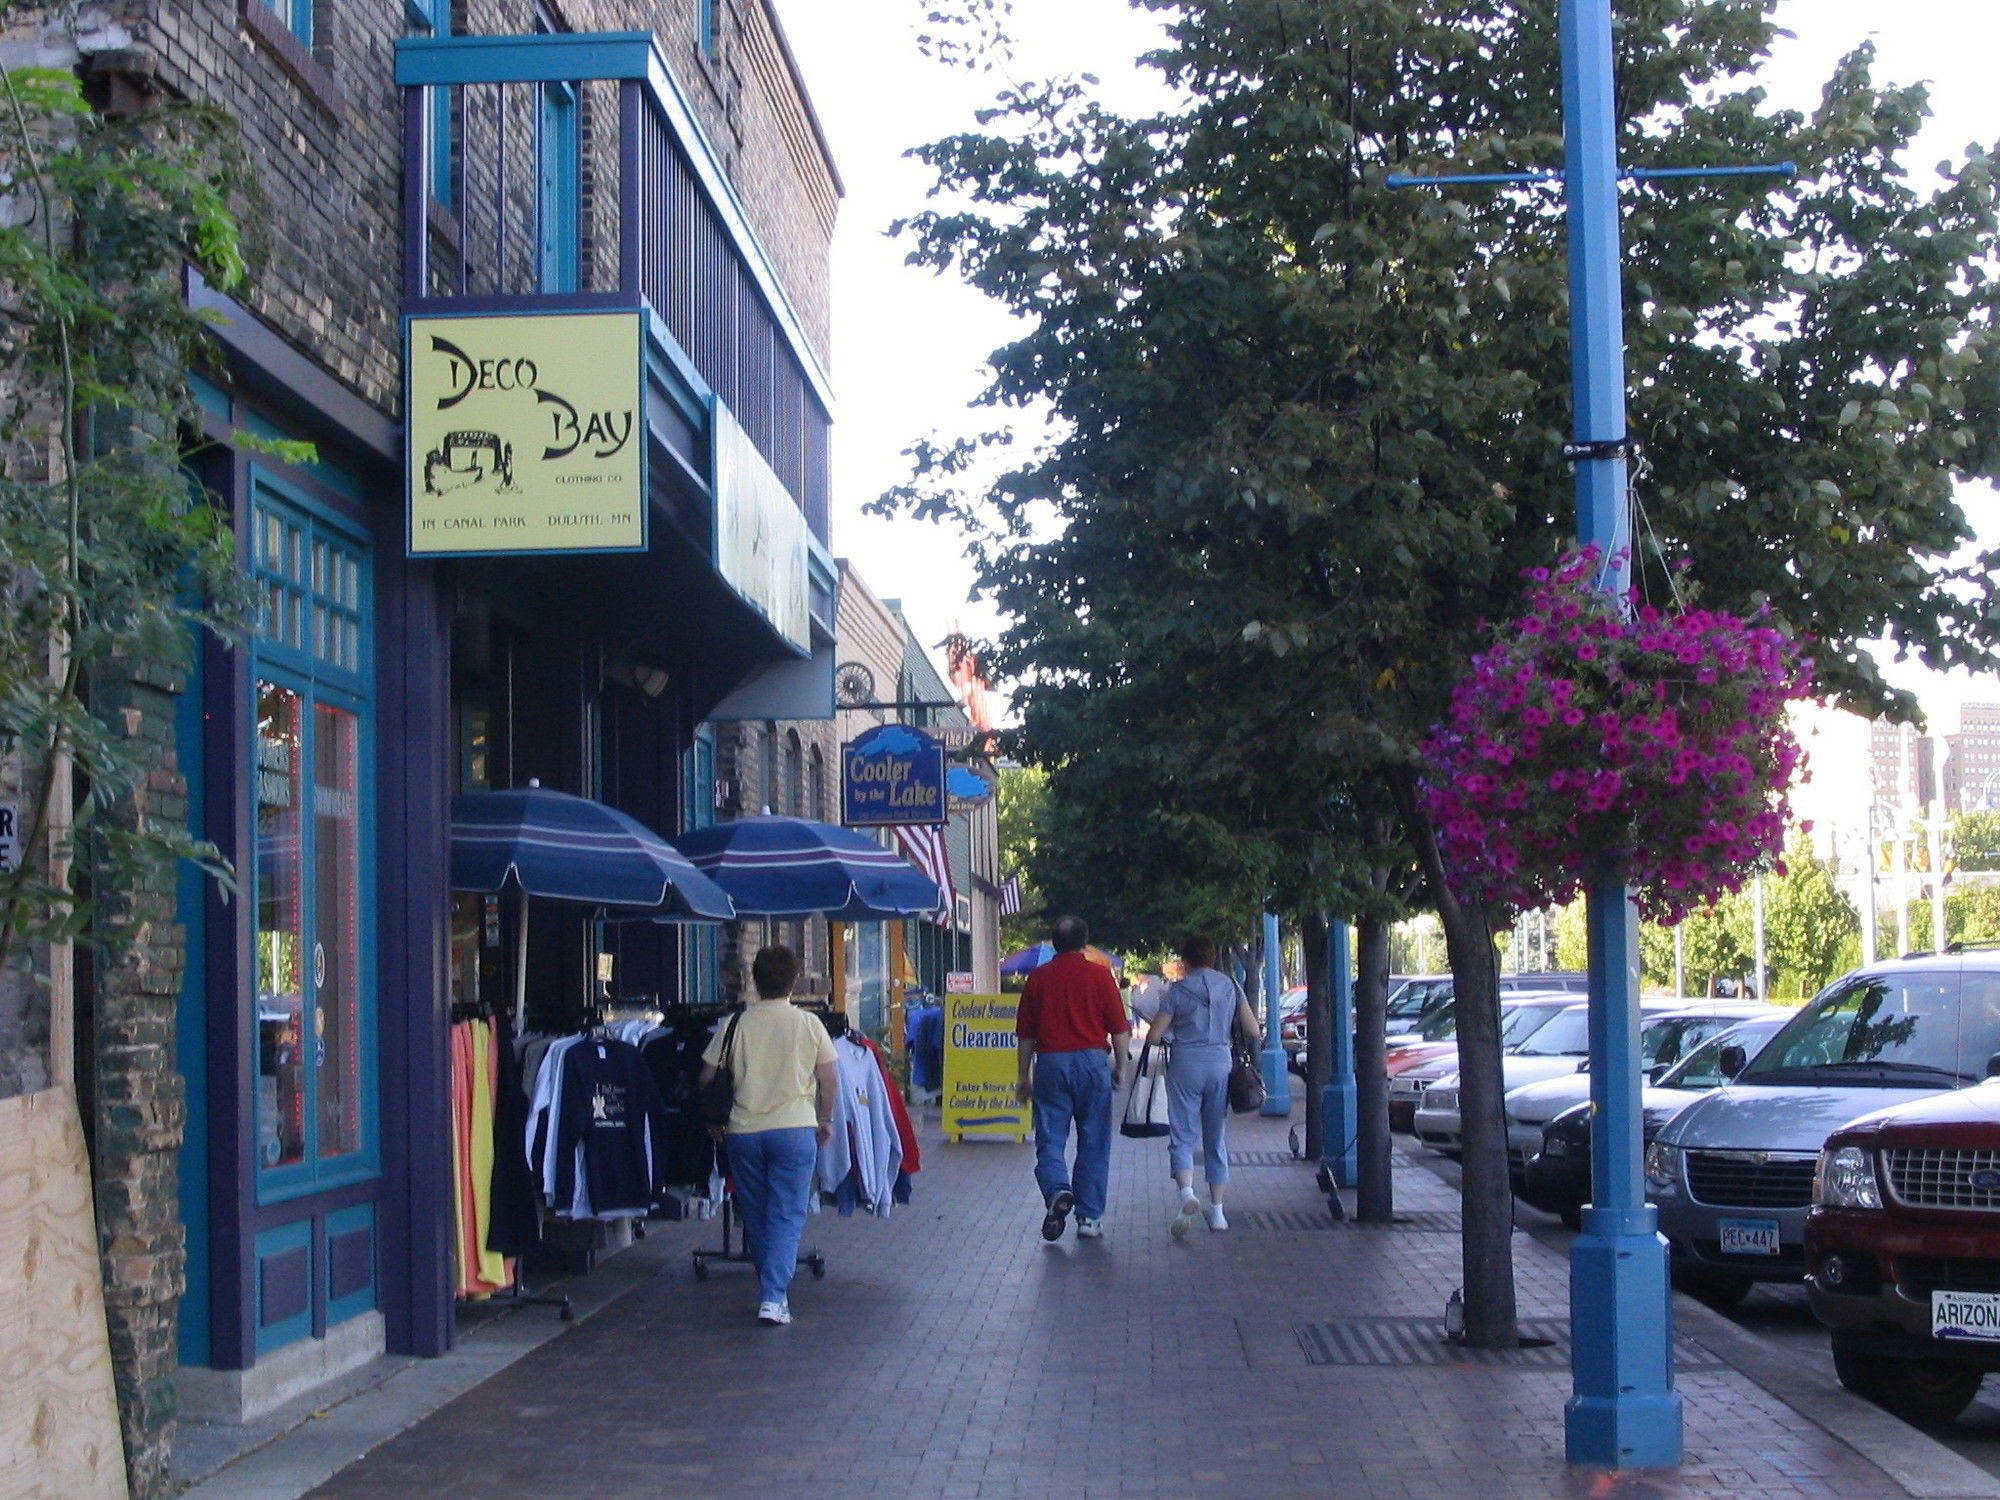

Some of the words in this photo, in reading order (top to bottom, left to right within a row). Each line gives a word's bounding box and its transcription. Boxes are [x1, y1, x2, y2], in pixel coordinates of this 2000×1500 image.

[431, 335, 537, 410] DECO
[532, 388, 632, 461] BAY
[555, 475, 602, 484] CLOTHING
[422, 519, 435, 529] IN
[443, 518, 486, 529] CANAL
[493, 516, 526, 528] PARK
[611, 513, 631, 524] MN
[849, 755, 912, 783] Cooler
[854, 789, 867, 803] by
[869, 789, 885, 801] the
[888, 779, 937, 807] Lake
[952, 999, 986, 1019] Coolest
[952, 1023, 1018, 1048] Clearanc
[956, 1082, 980, 1092] Enter
[983, 1081, 1006, 1092] Store
[950, 1096, 976, 1109] Cooler
[977, 1095, 987, 1112] by
[989, 1096, 1002, 1109] the
[1723, 1230, 1746, 1247] PEC
[1752, 1230, 1774, 1247] 447
[1936, 1302, 2000, 1327] ARIZON
